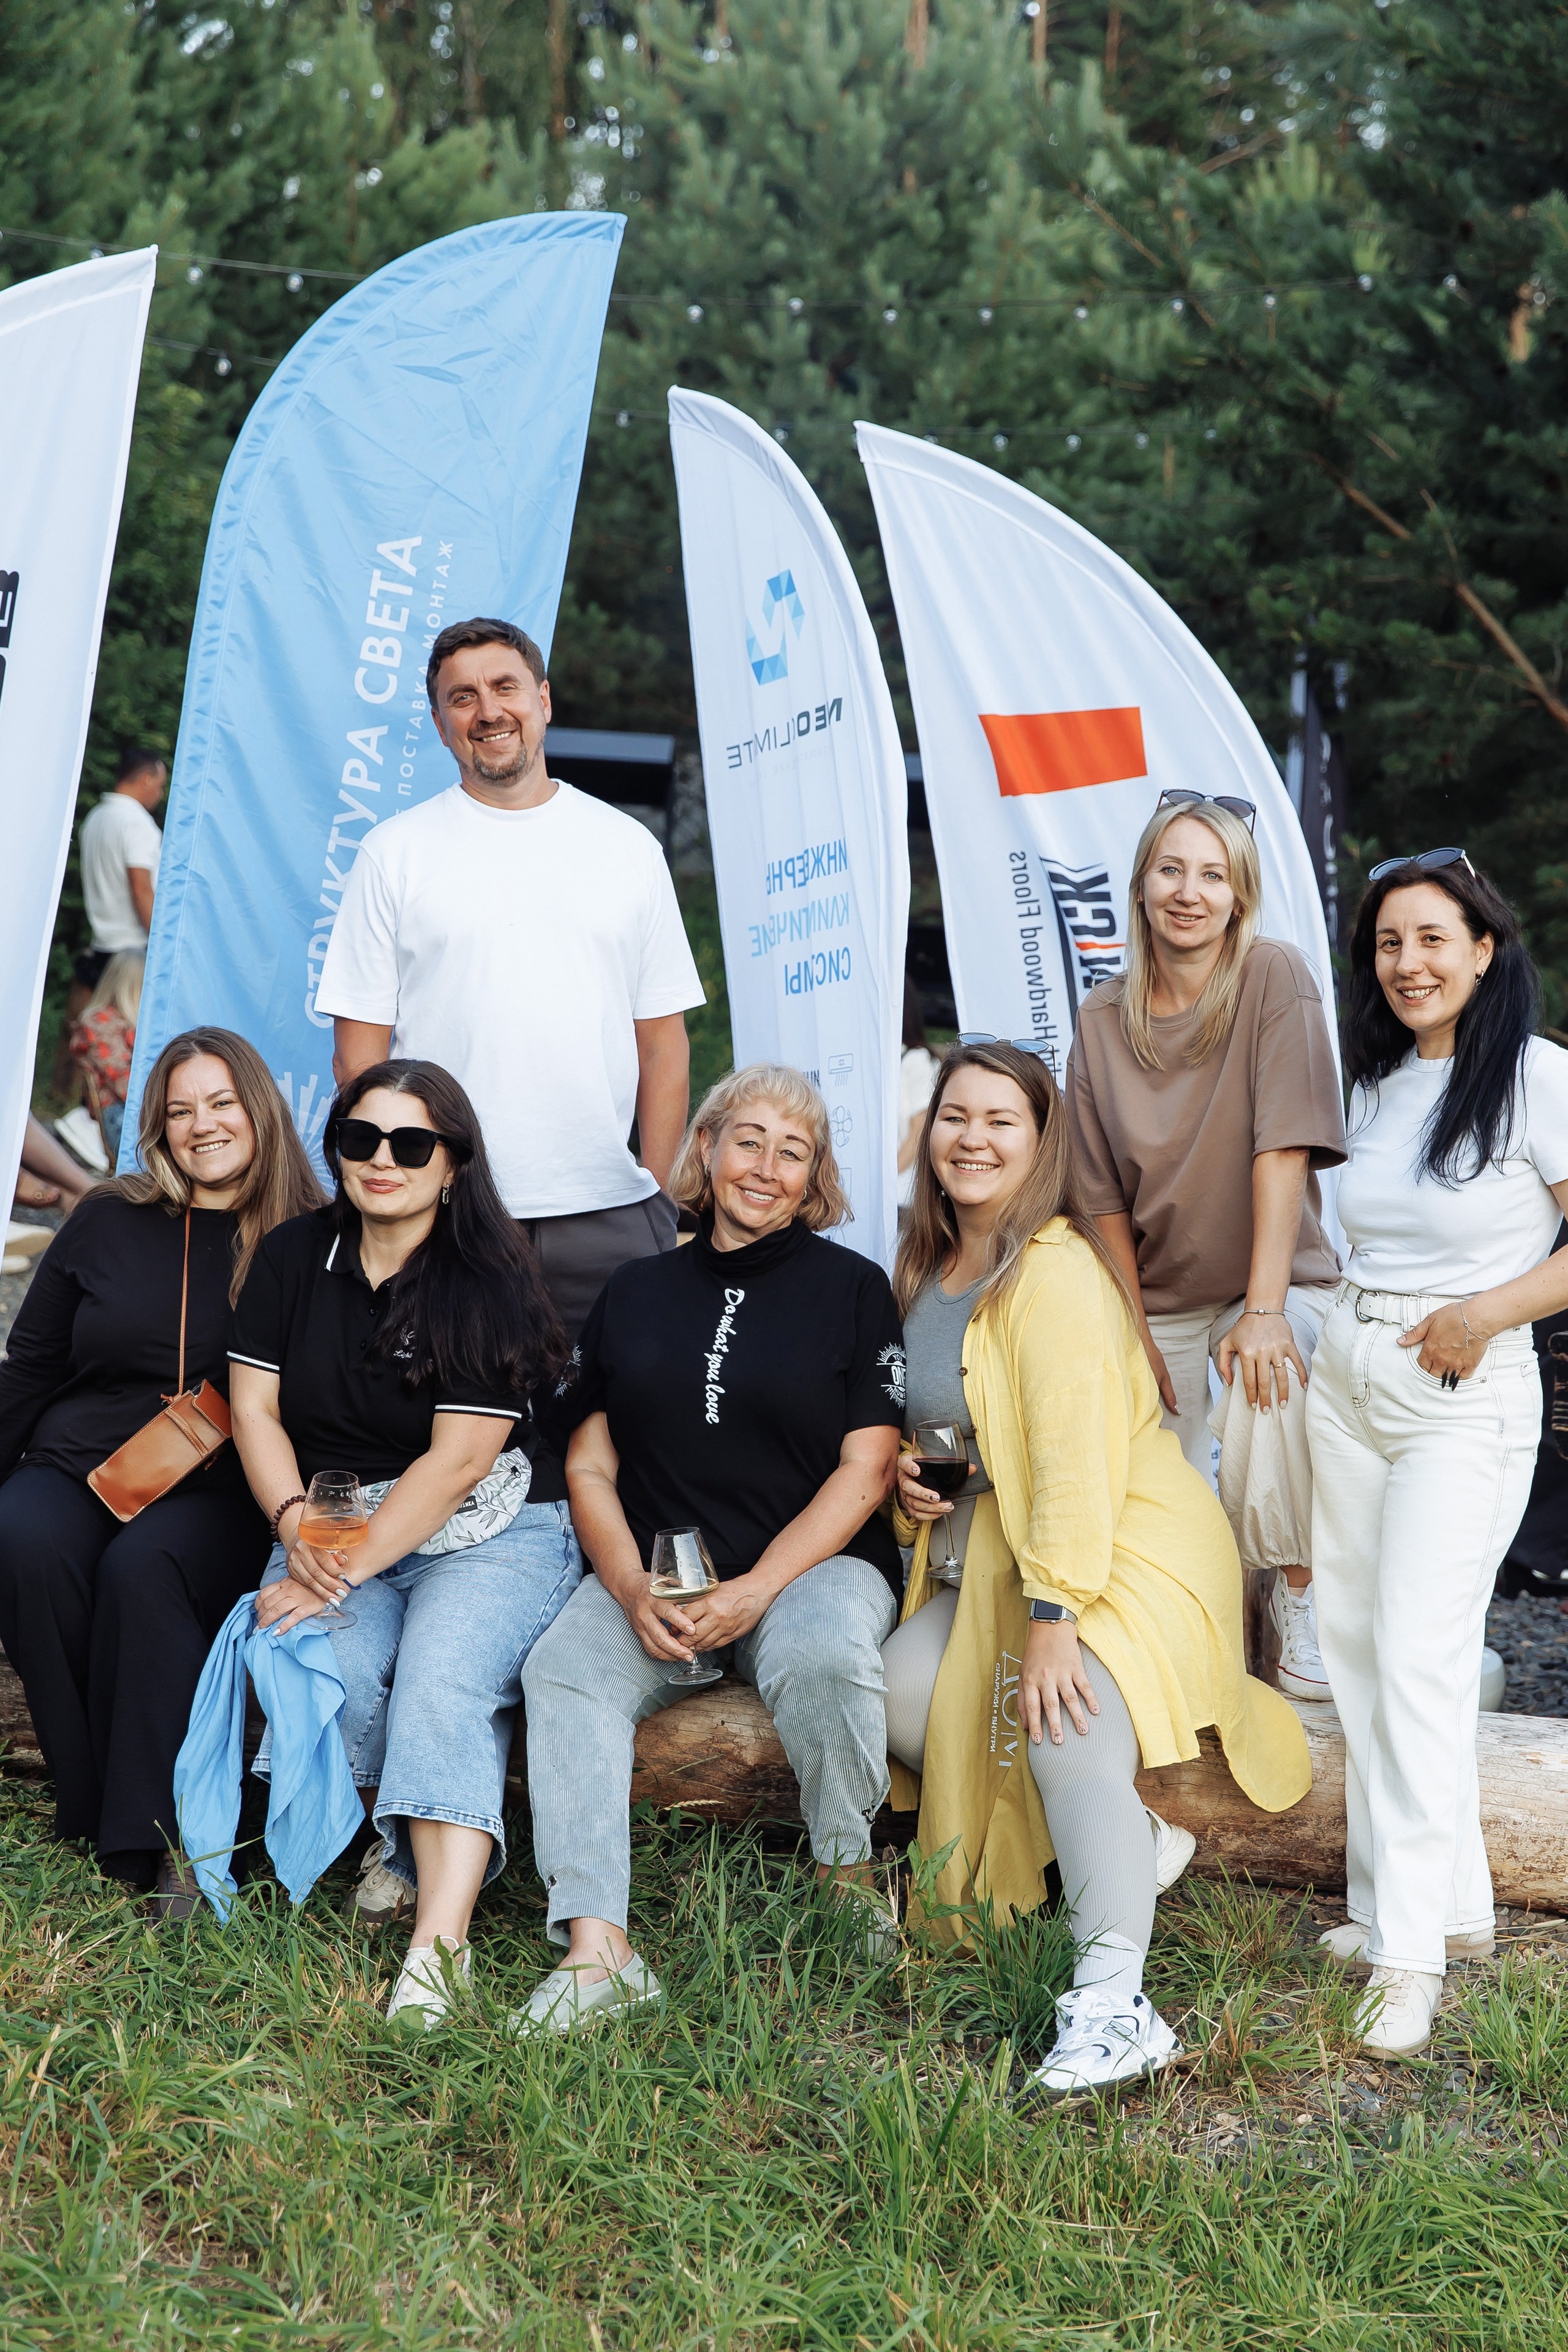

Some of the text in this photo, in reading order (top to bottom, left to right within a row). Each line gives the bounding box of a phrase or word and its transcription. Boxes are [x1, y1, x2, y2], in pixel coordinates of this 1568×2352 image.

[353, 535, 423, 705] СВЕТА
[422, 540, 454, 651] МОНТАЖ
[704, 1288, 745, 1424] Do what you love
[990, 1716, 998, 1752] ВНУТРИ
